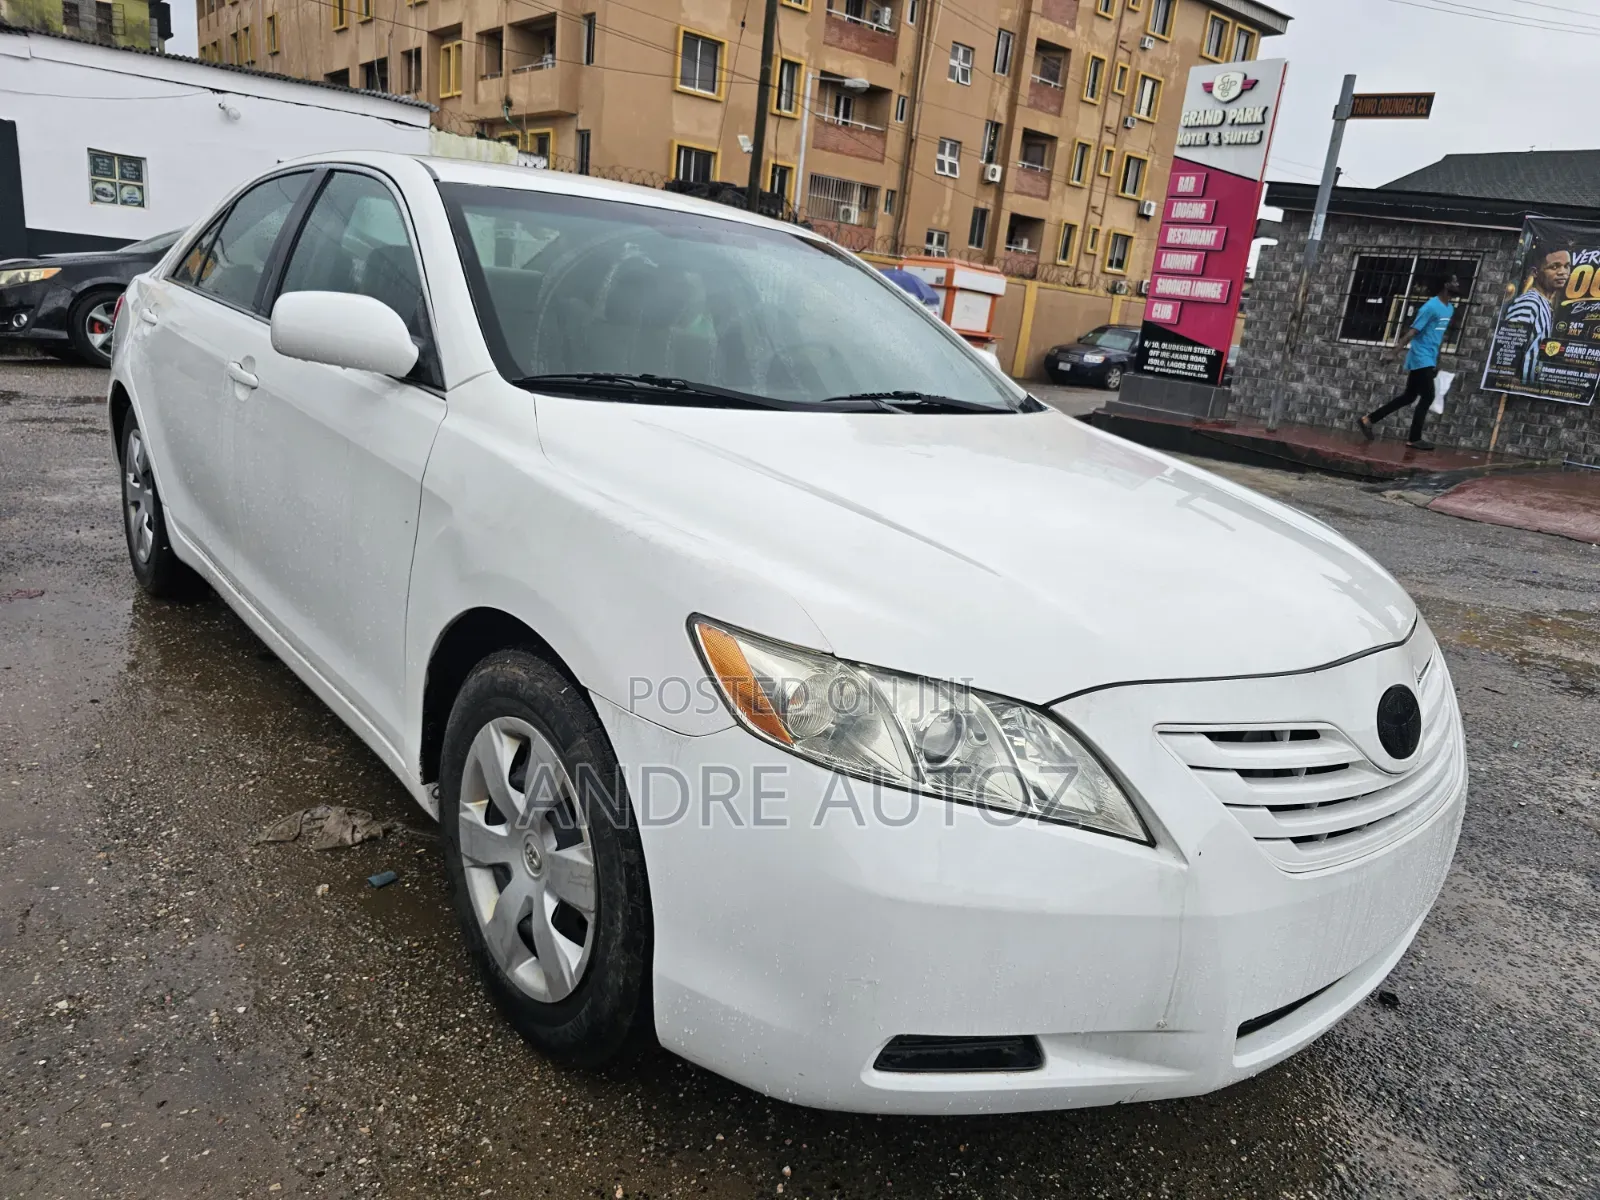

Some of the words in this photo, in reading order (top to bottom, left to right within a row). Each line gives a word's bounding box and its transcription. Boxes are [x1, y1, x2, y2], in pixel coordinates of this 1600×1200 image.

[1353, 98, 1378, 114] TAIWO
[1378, 98, 1416, 114] ODUNUGA
[1417, 98, 1428, 114] CL
[1181, 109, 1224, 127] GRAND
[1228, 106, 1266, 125] PARK
[1177, 132, 1208, 146] HOTEL
[1210, 132, 1220, 145] &
[1223, 130, 1262, 145] SUITES
[1177, 176, 1196, 193] BAR
[1171, 201, 1207, 219] LODGING
[1166, 227, 1218, 246] RESTAURANT
[1160, 253, 1198, 270] LAUNDRY
[1573, 249, 1600, 266] VER
[1155, 278, 1192, 296] SNOOKER
[1191, 281, 1223, 299] LOUNGE
[1152, 303, 1173, 320] CLUB
[1148, 349, 1160, 357] OFF
[1565, 346, 1587, 355] GRAND
[1587, 348, 1600, 358] PAR
[1167, 360, 1186, 370] LAGOS
